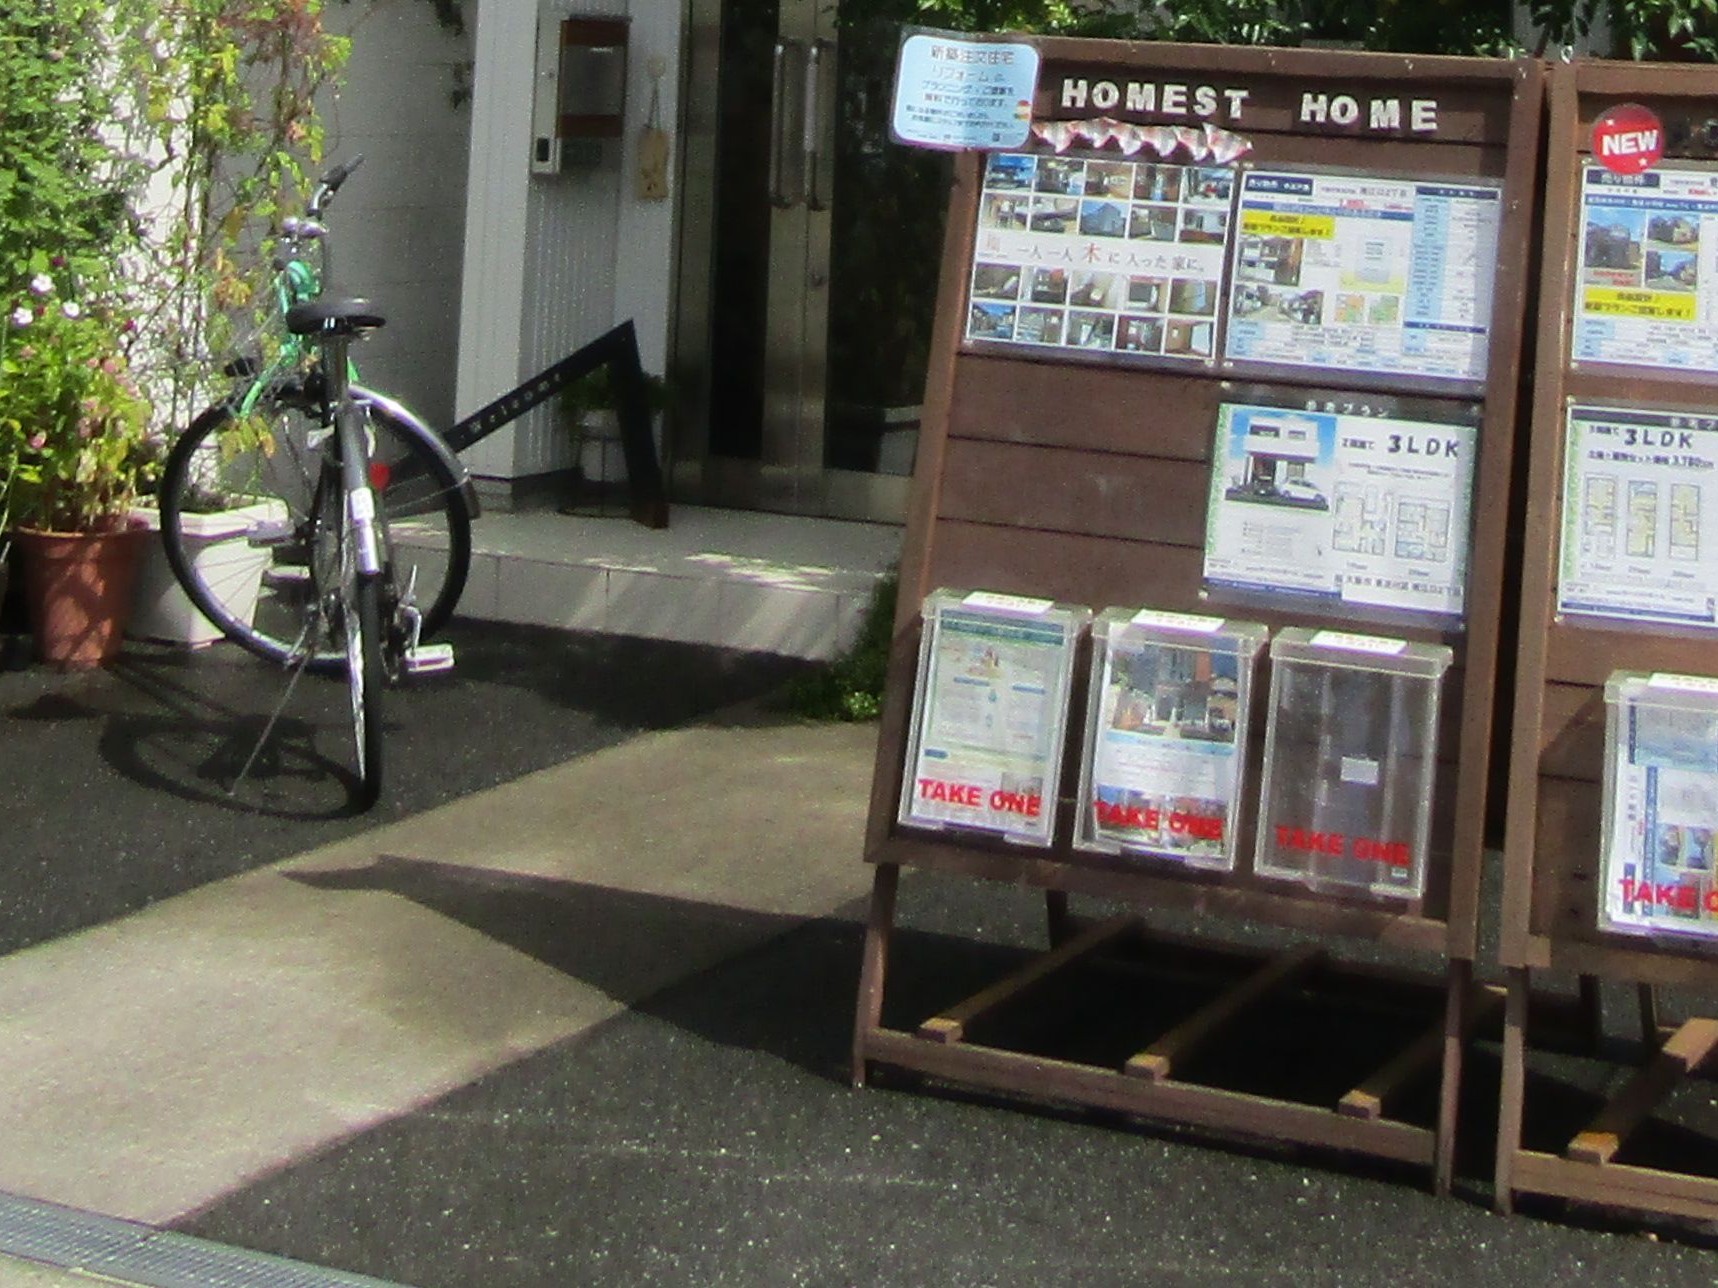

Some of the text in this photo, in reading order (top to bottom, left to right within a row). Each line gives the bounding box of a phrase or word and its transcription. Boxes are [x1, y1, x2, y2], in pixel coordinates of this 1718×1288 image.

[1062, 78, 1439, 132] HOMEST HOME
[1602, 129, 1658, 157] NEW
[1387, 434, 1461, 458] 3LDK
[1624, 428, 1694, 449] 3LDK
[918, 778, 1042, 818] TAKE ONE
[1093, 800, 1225, 841] TAKE ONE
[1274, 824, 1411, 867] TAKE ONE
[1619, 878, 1696, 913] TAKE
